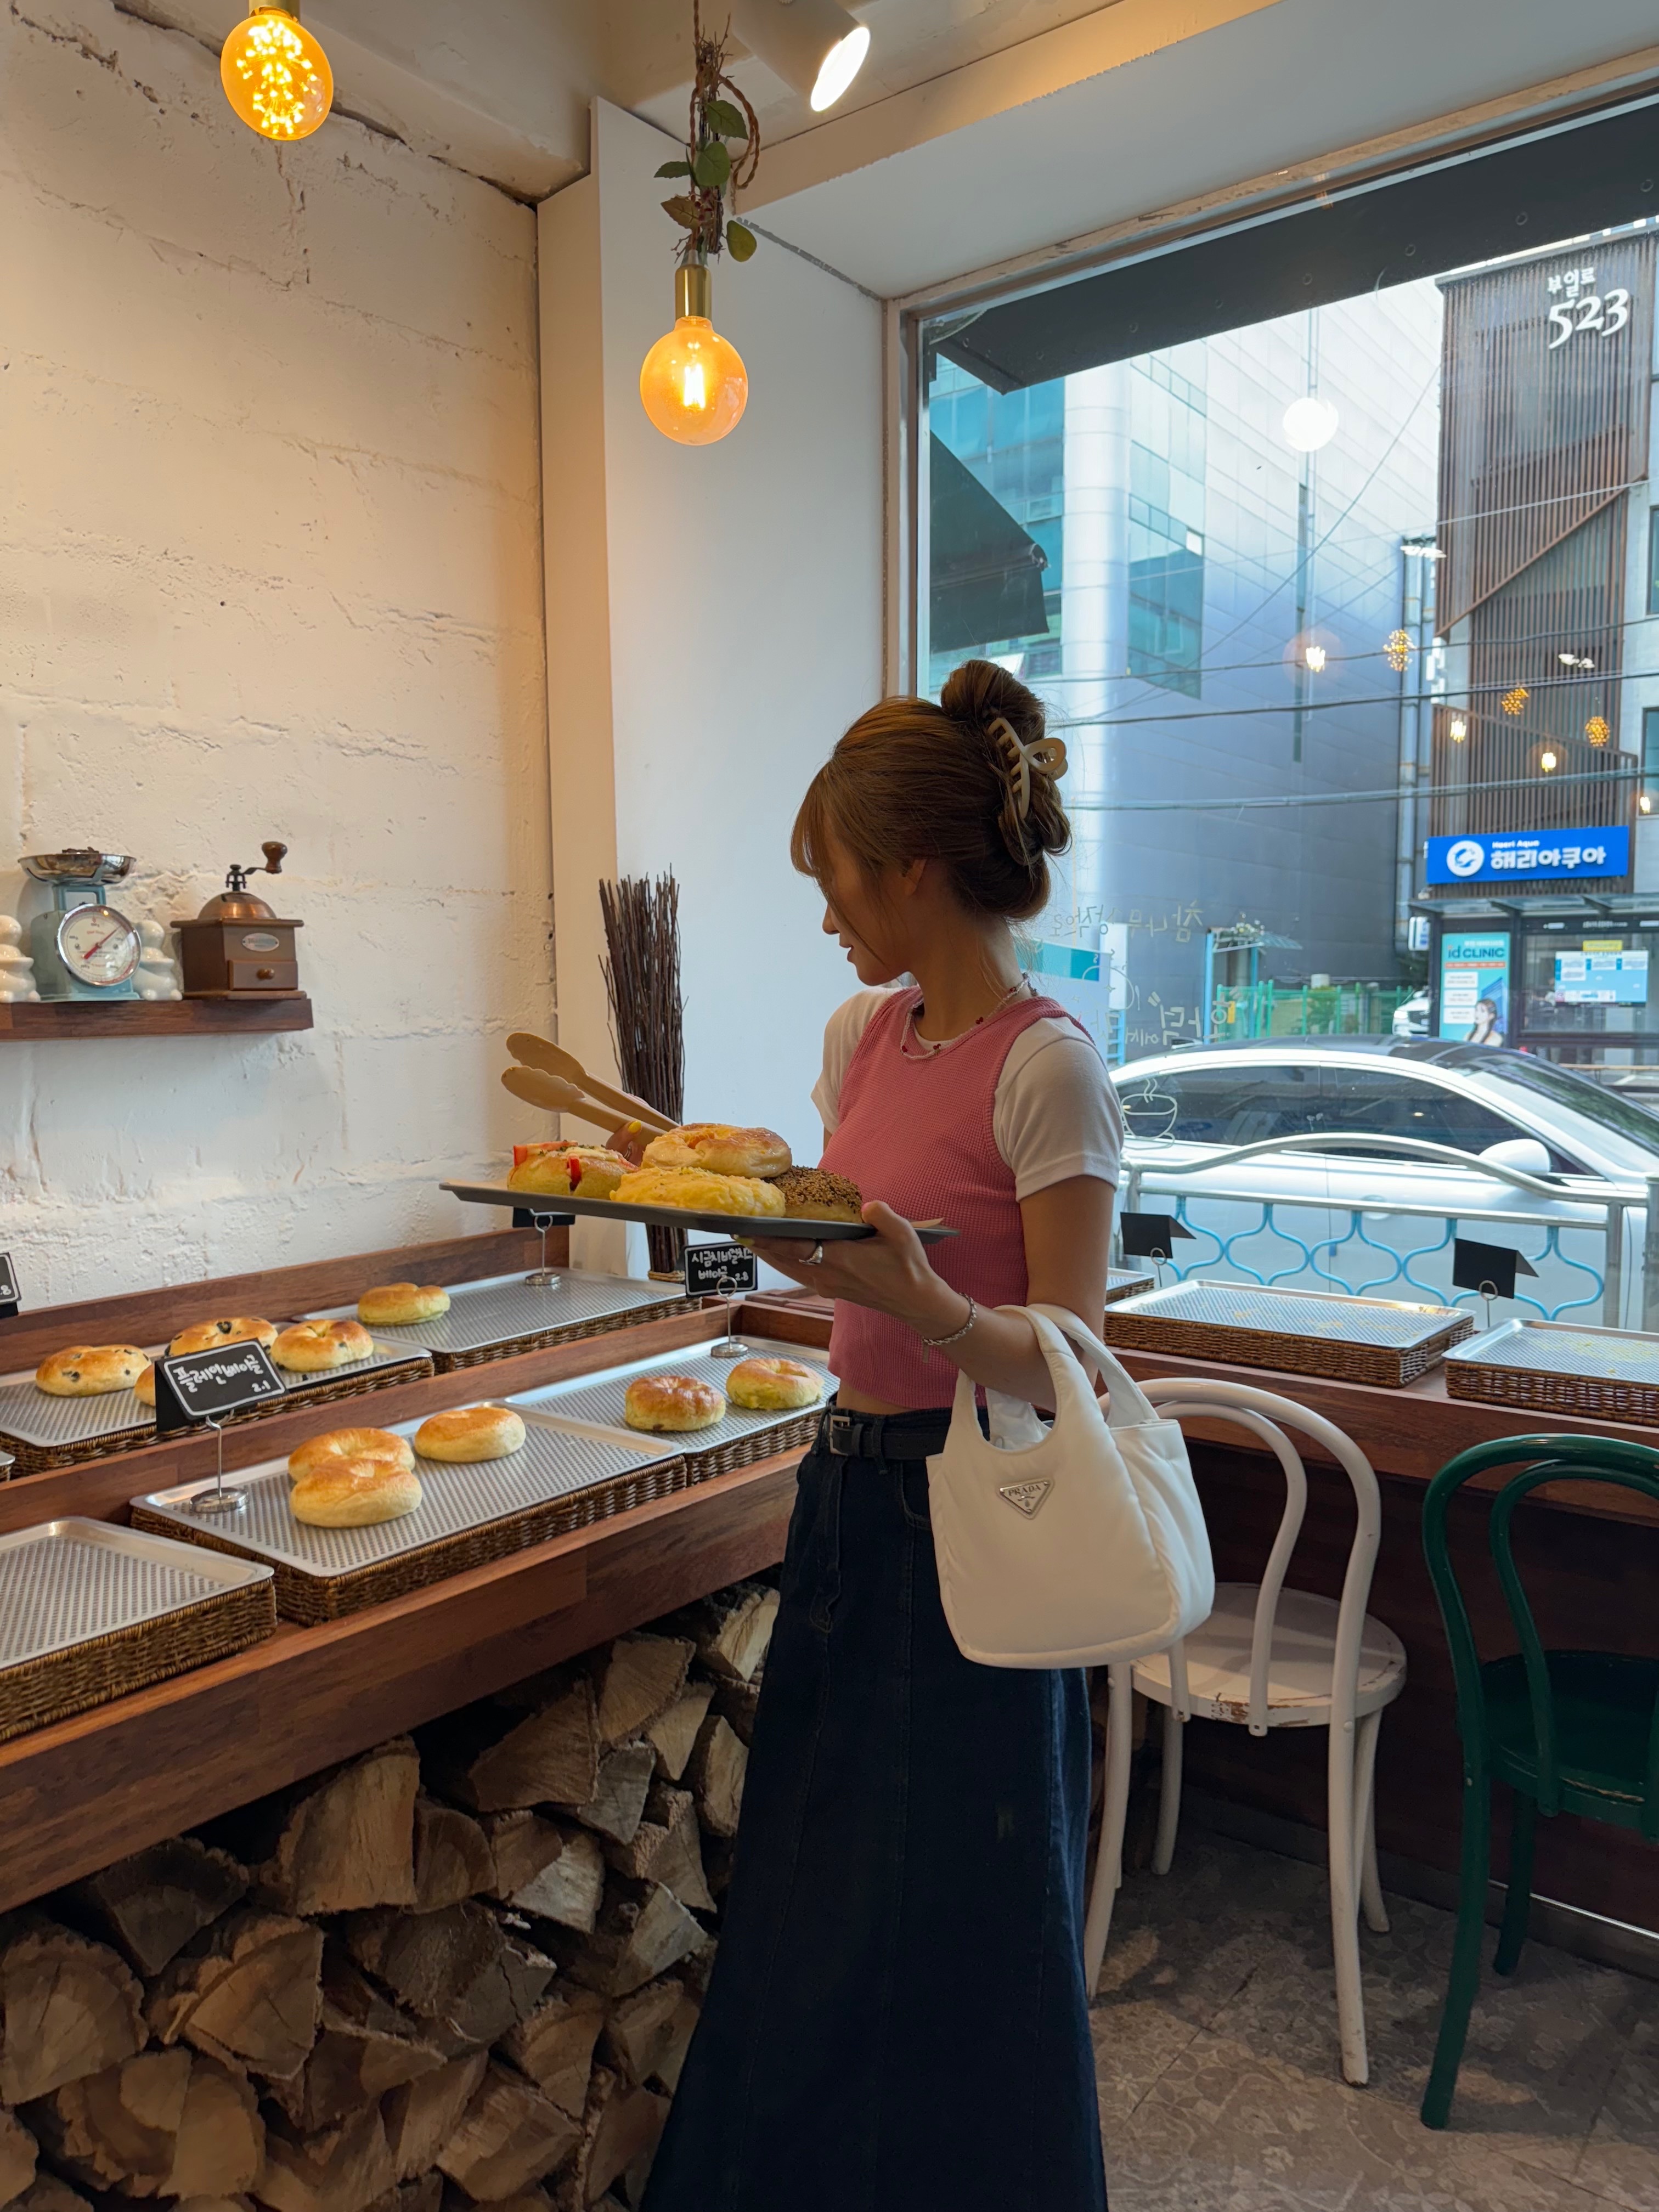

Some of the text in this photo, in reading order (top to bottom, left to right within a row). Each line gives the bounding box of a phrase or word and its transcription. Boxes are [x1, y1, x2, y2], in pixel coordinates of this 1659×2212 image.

[1548, 267, 1595, 298] 부일로
[1549, 288, 1628, 349] 523
[1491, 846, 1606, 869] 해리아쿠아
[1463, 948, 1505, 958] CLINIC
[735, 1271, 749, 1281] 2.8
[252, 1380, 271, 1392] 2.1
[1008, 1485, 1041, 1496] PRADA
